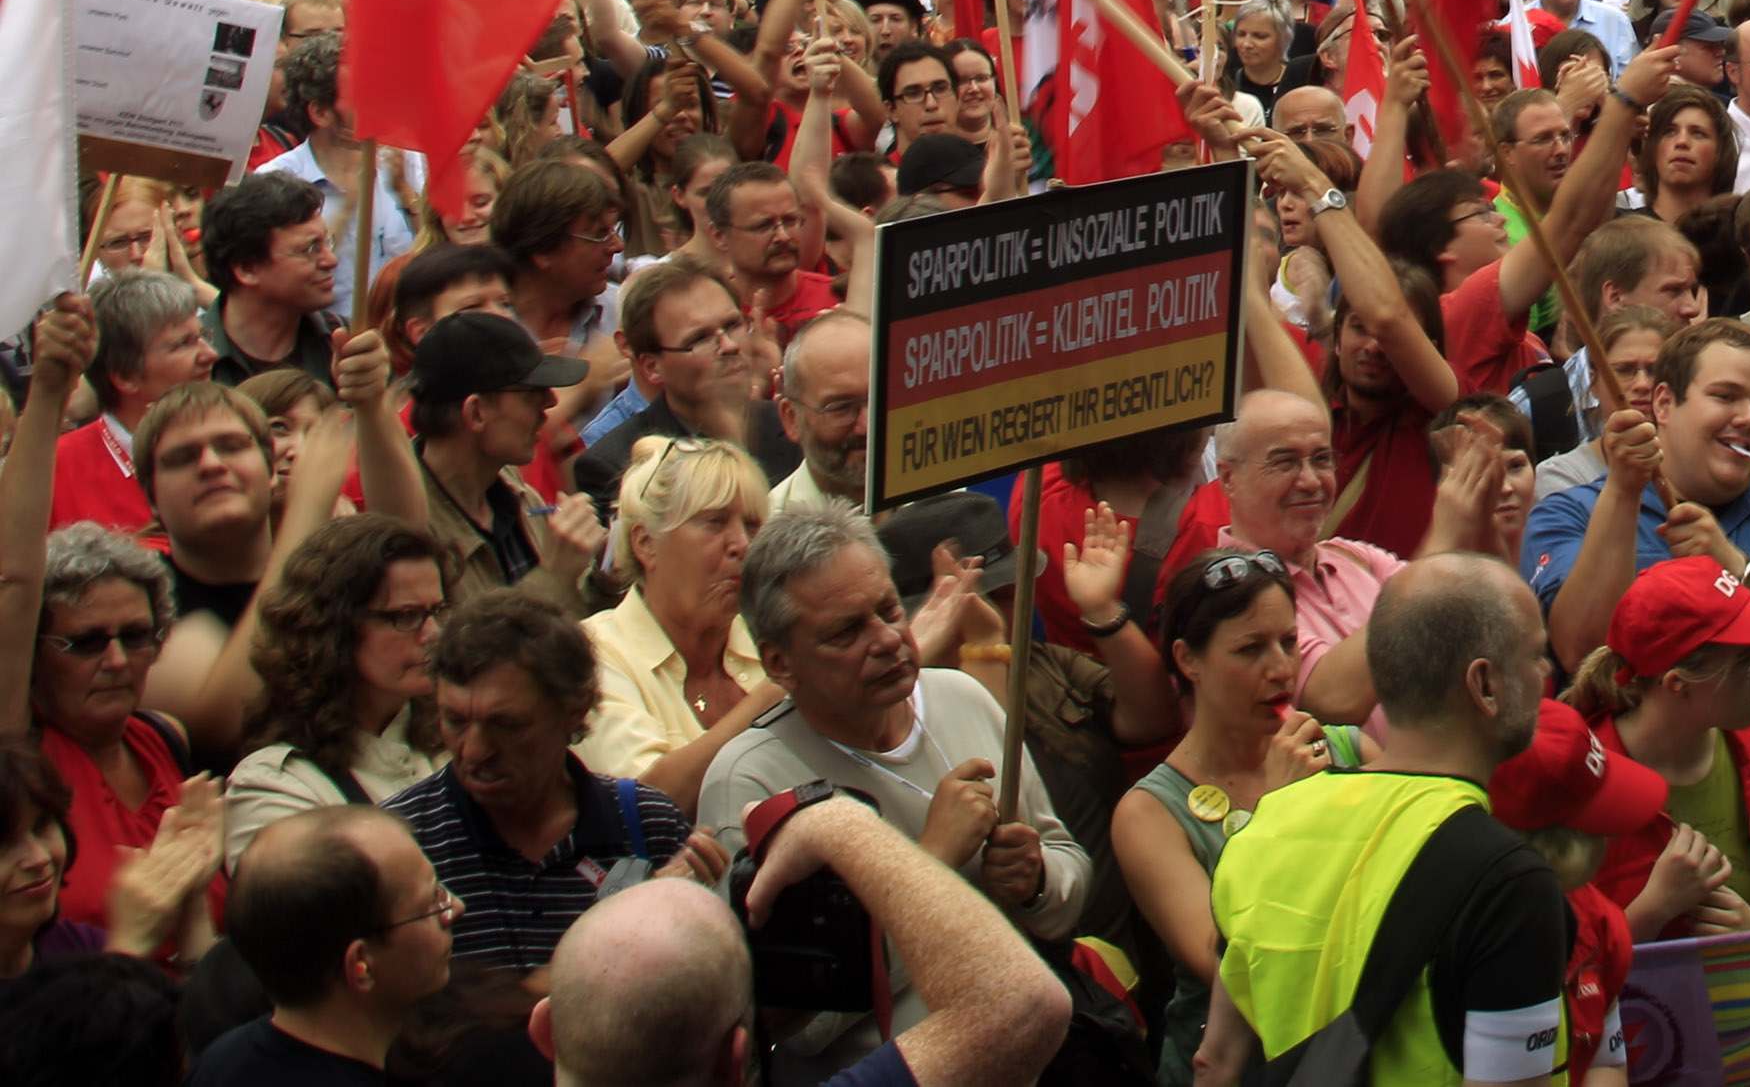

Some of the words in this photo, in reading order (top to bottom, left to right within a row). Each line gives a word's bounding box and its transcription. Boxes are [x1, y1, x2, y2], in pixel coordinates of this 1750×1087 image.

[907, 228, 1031, 299] SPARPOLITIK
[1049, 205, 1148, 269] UNSOZIALE
[1154, 191, 1227, 247] POLITIK
[904, 311, 1033, 389] SPARPOLITIK
[1052, 288, 1138, 353] KLIENTEL
[1146, 271, 1220, 332] POLITIK
[902, 419, 937, 473] FÜR
[942, 415, 985, 463] WEN
[988, 396, 1066, 450] REGIERT
[1068, 388, 1099, 432] IHR
[1102, 360, 1216, 422] EIGENTLICH?
